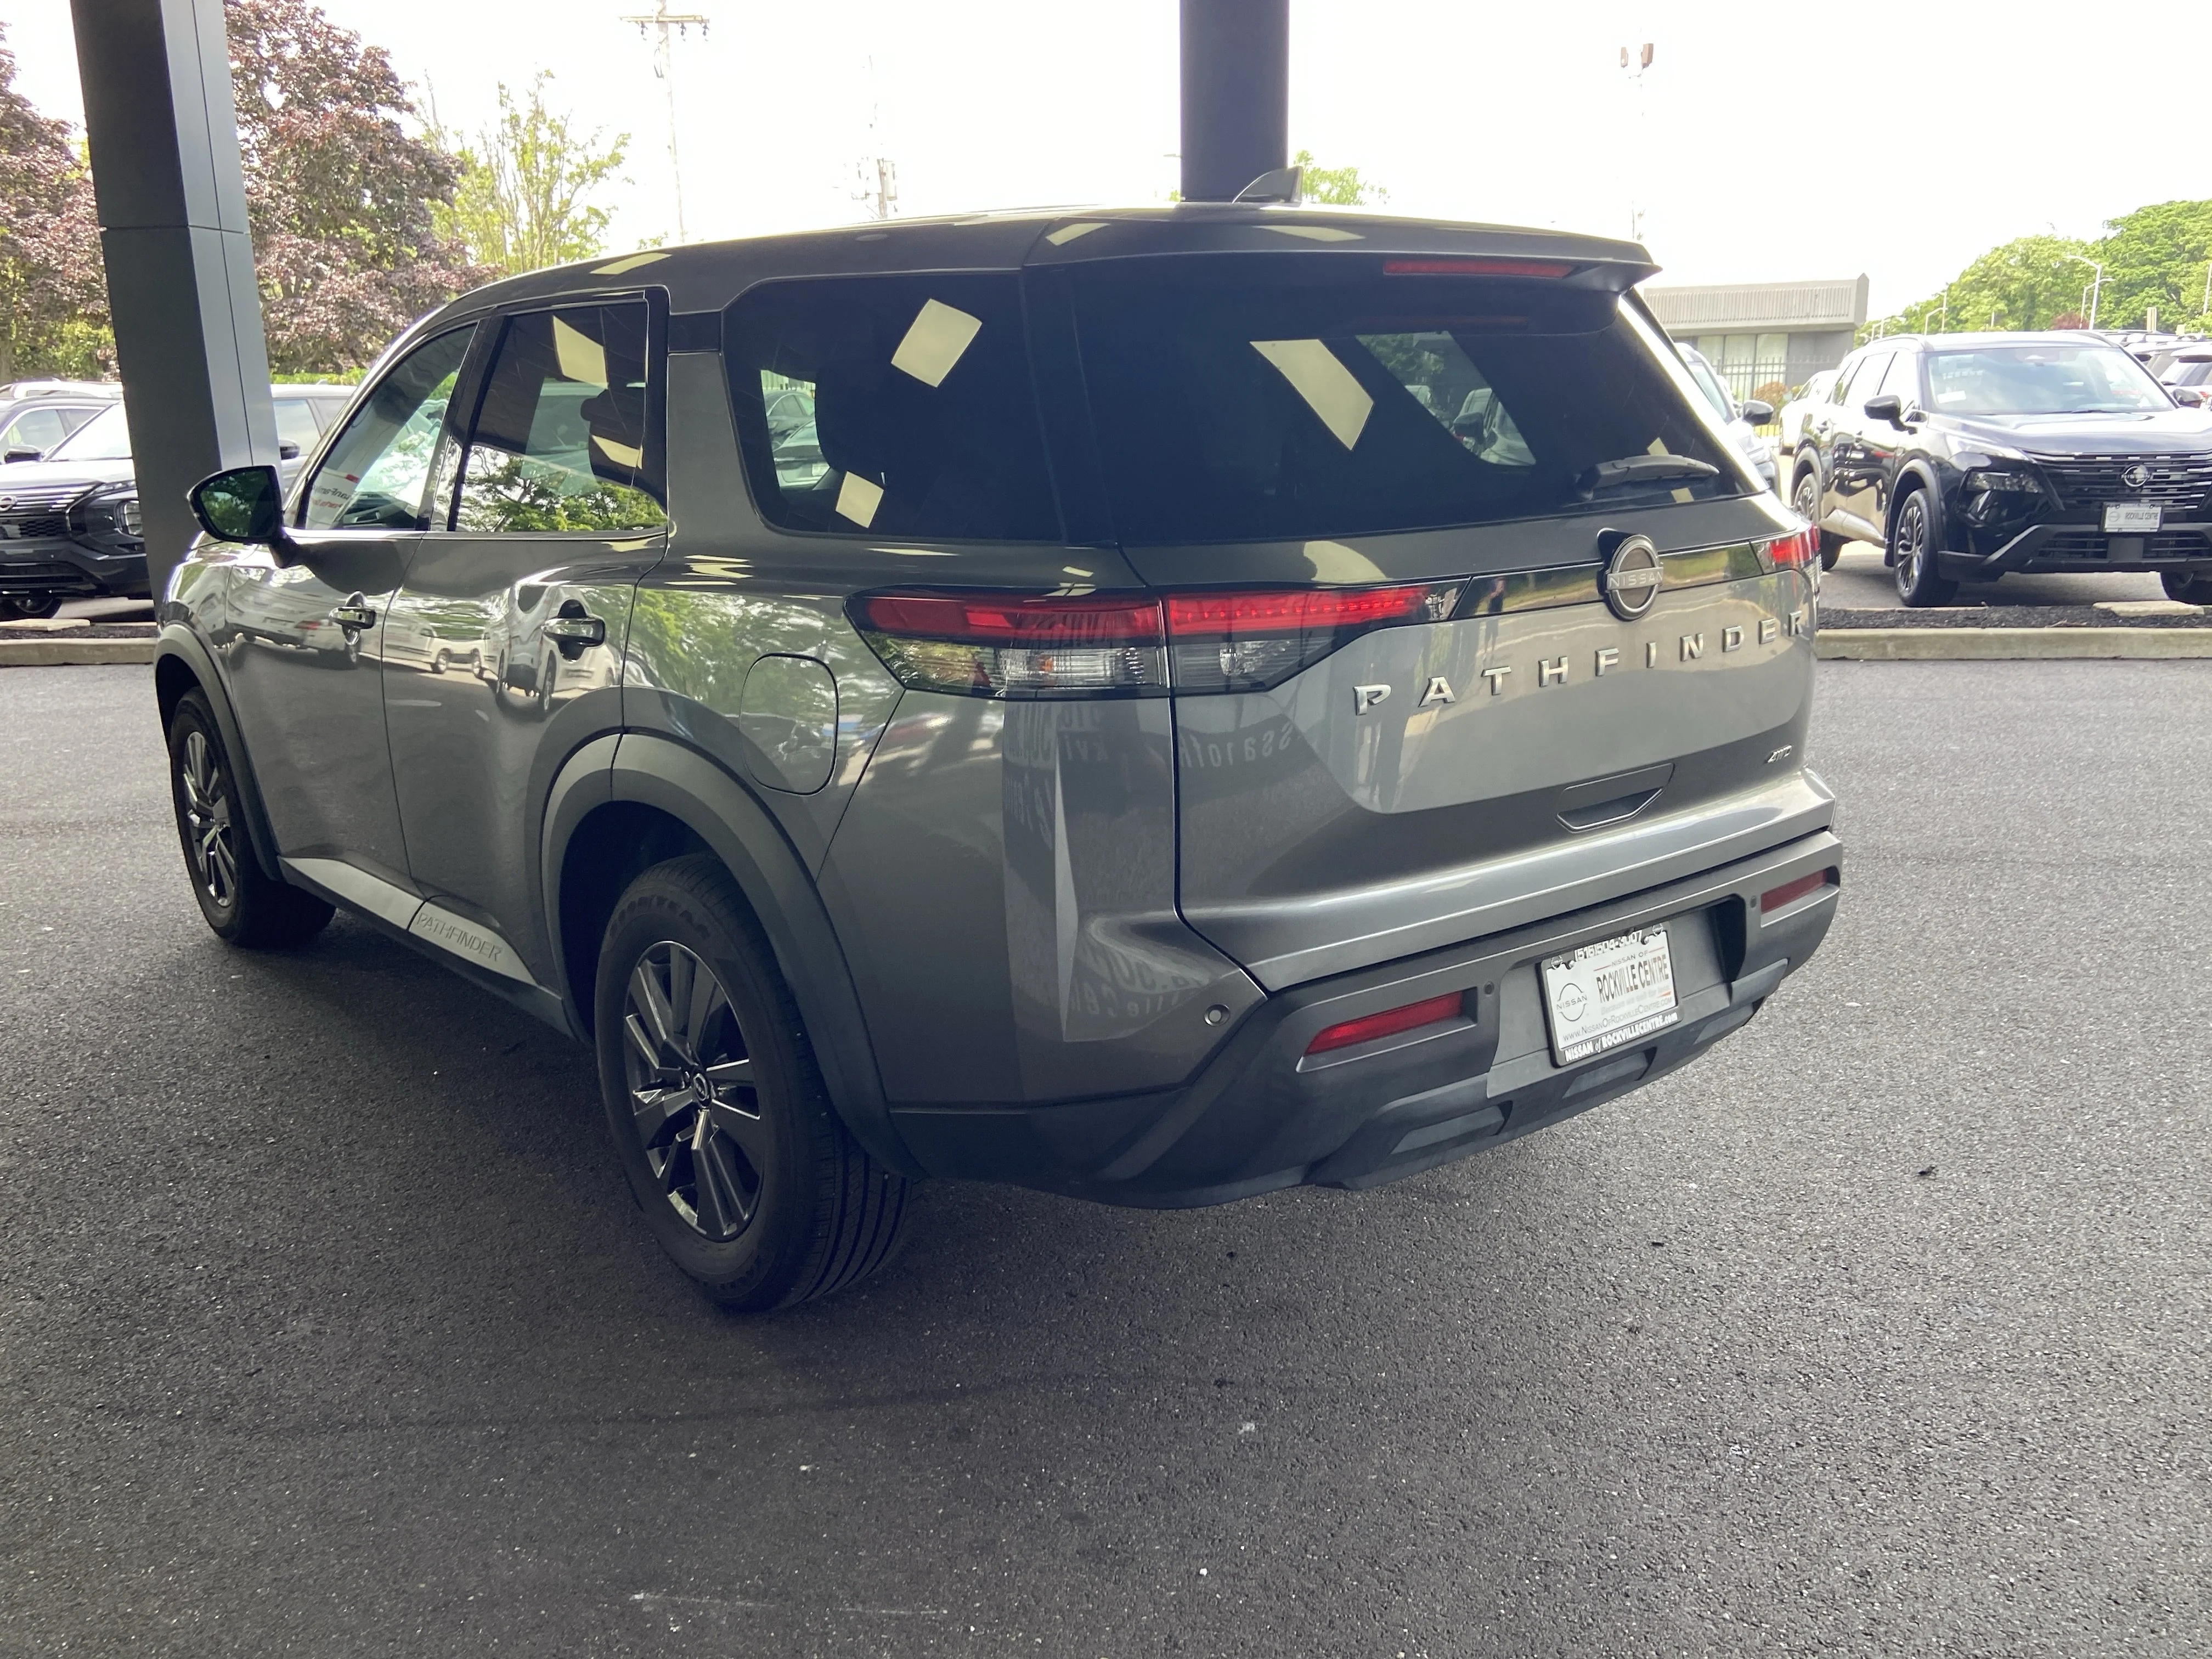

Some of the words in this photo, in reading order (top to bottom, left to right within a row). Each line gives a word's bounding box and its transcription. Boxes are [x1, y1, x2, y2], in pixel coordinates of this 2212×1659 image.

[1609, 571, 1663, 587] NISSAN
[1353, 611, 1804, 715] PATHFINDER
[416, 912, 503, 961] PATHFINDER
[1611, 953, 1636, 967] NISSAN
[1596, 964, 1639, 1003] ROCKVILLE
[1638, 954, 1669, 989] CENTRE
[1556, 995, 1588, 1010] NISSAN
[1565, 1041, 1594, 1062] NISSAN
[1595, 1036, 1601, 1053] of
